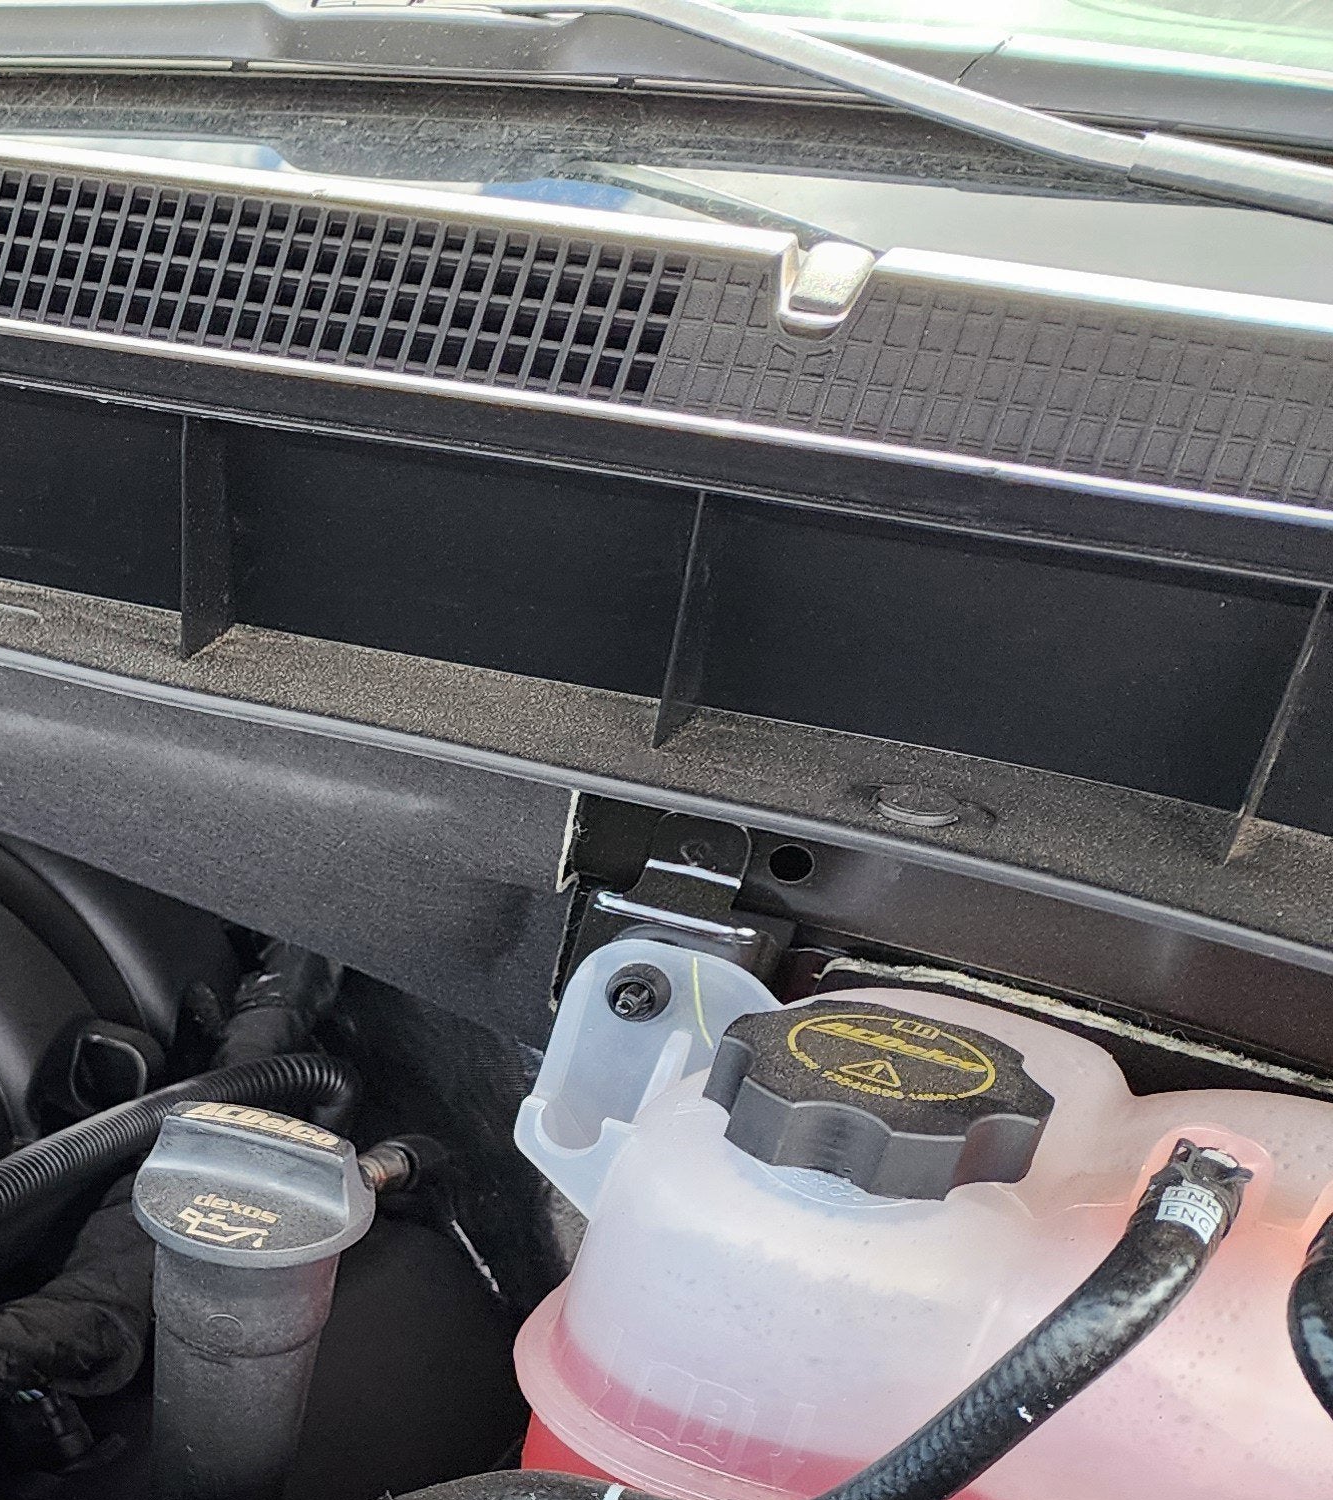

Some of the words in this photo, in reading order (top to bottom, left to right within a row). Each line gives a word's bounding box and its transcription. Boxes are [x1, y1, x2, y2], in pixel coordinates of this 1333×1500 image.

[185, 1102, 341, 1148] ACDelco
[192, 1192, 282, 1225] dexos
[1164, 1205, 1212, 1233] ENG
